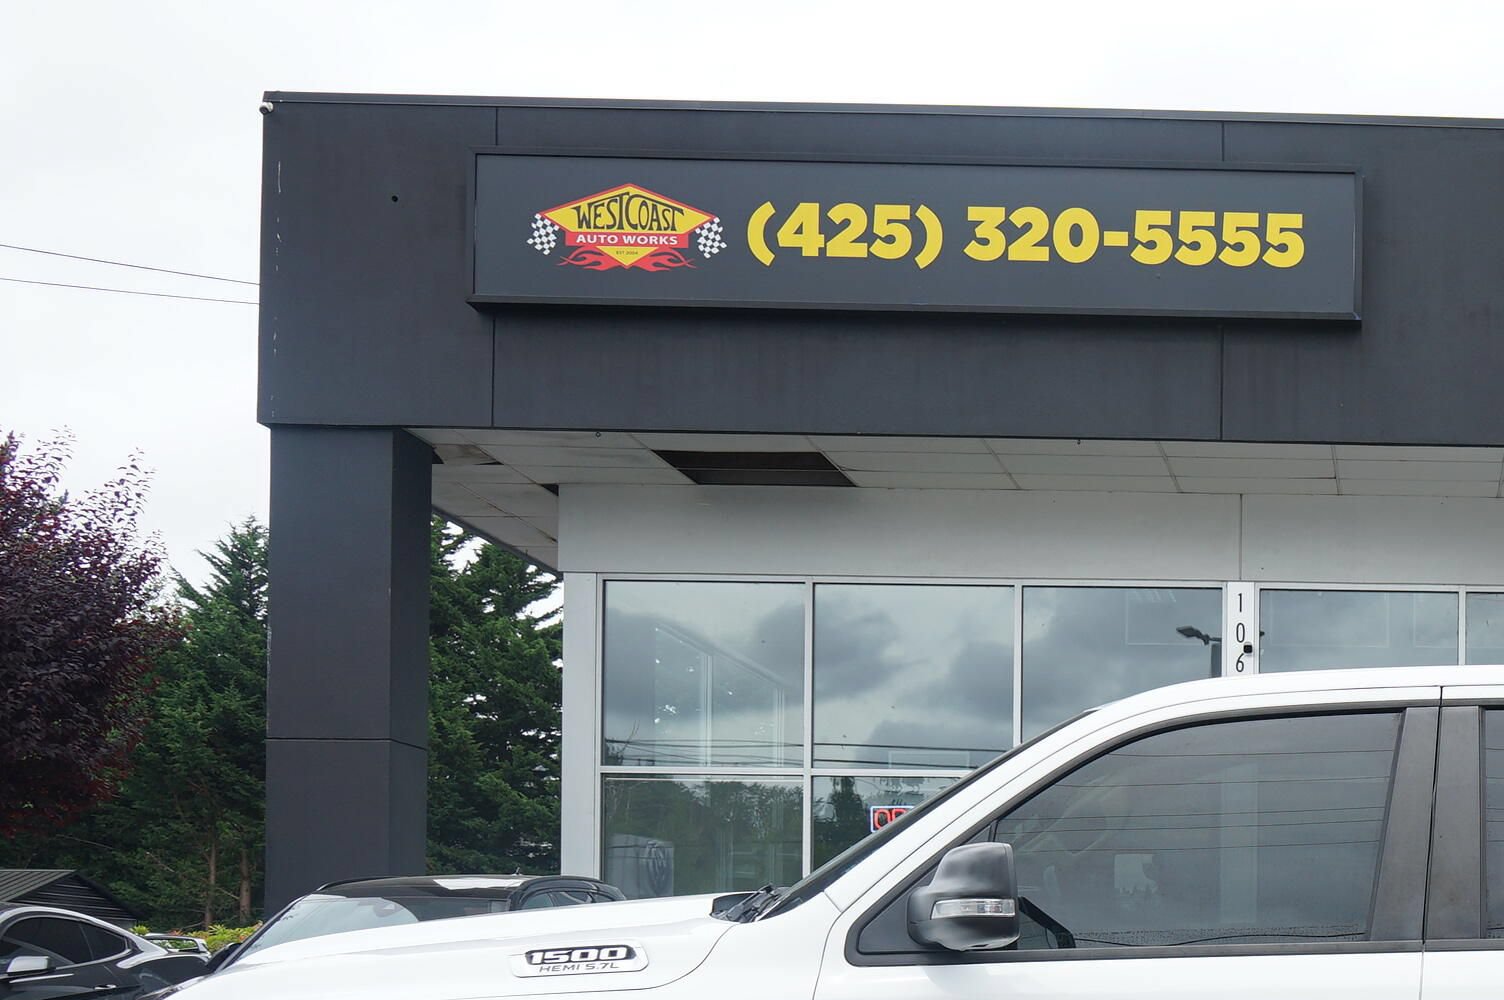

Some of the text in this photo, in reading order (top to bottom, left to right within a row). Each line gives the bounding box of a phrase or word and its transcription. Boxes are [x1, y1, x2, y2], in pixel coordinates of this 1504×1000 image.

[576, 234, 678, 245] AUTO WORKS
[747, 201, 1305, 269] (425) 320-5555
[529, 946, 629, 965] 1500
[539, 962, 620, 973] HEMI 5.7L
